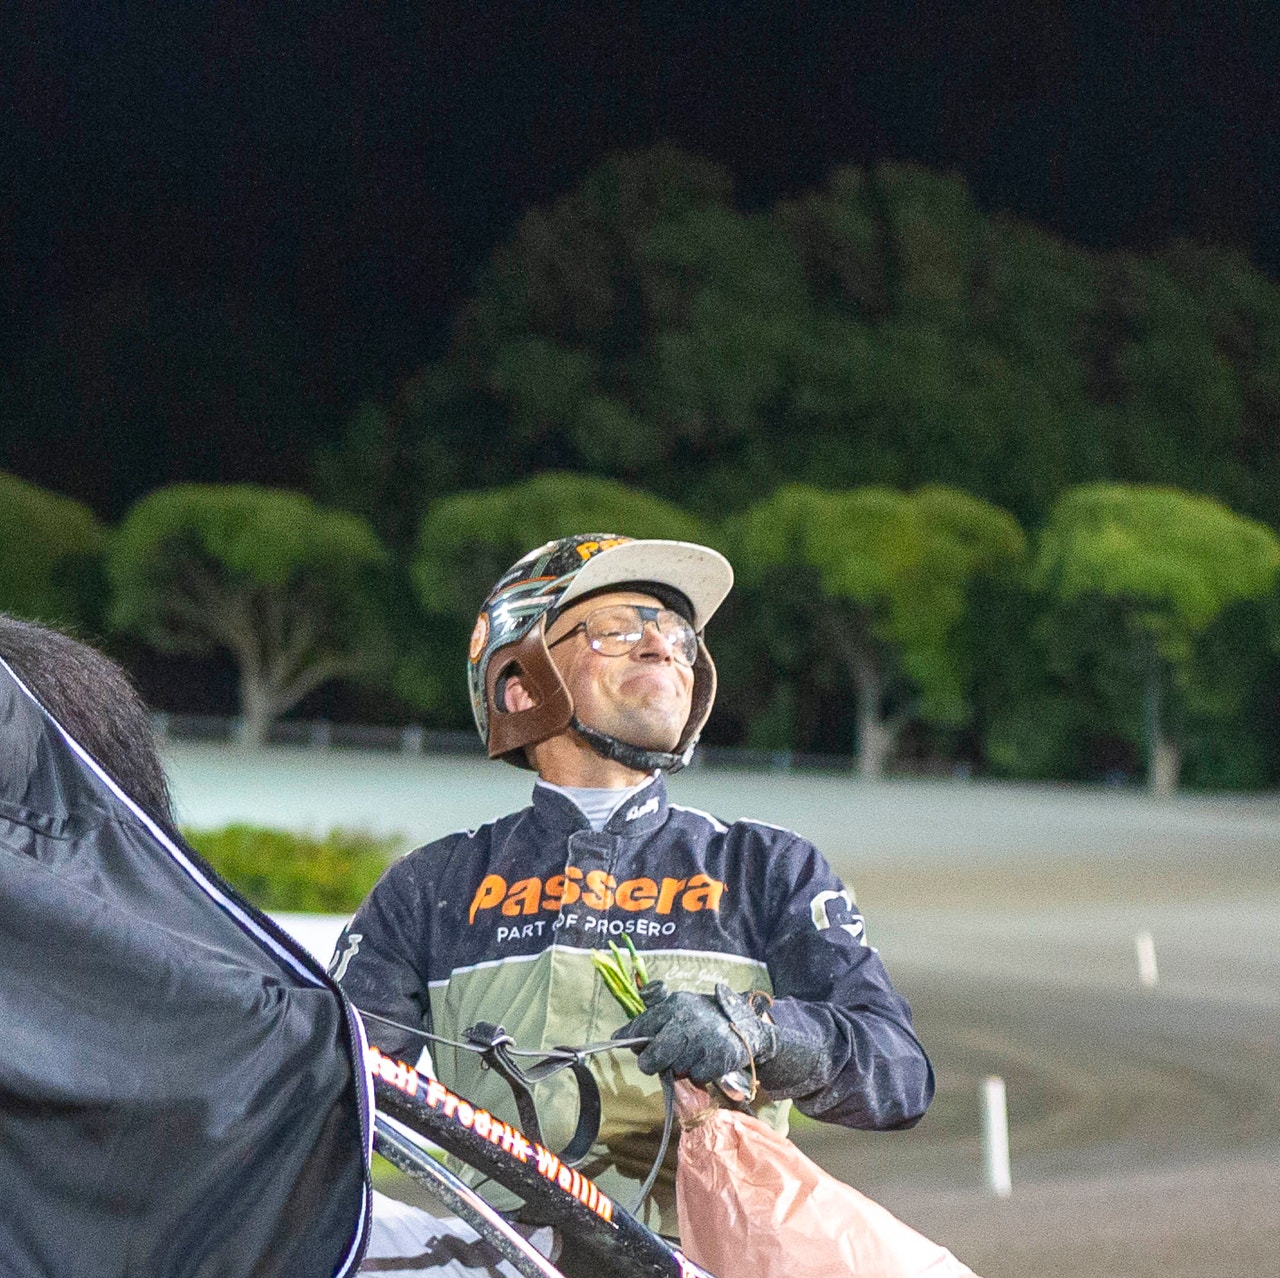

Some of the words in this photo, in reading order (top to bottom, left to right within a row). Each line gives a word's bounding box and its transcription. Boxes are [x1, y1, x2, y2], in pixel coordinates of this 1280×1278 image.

[497, 920, 546, 943] PART
[551, 913, 578, 932] OF
[584, 915, 677, 937] PROSERO
